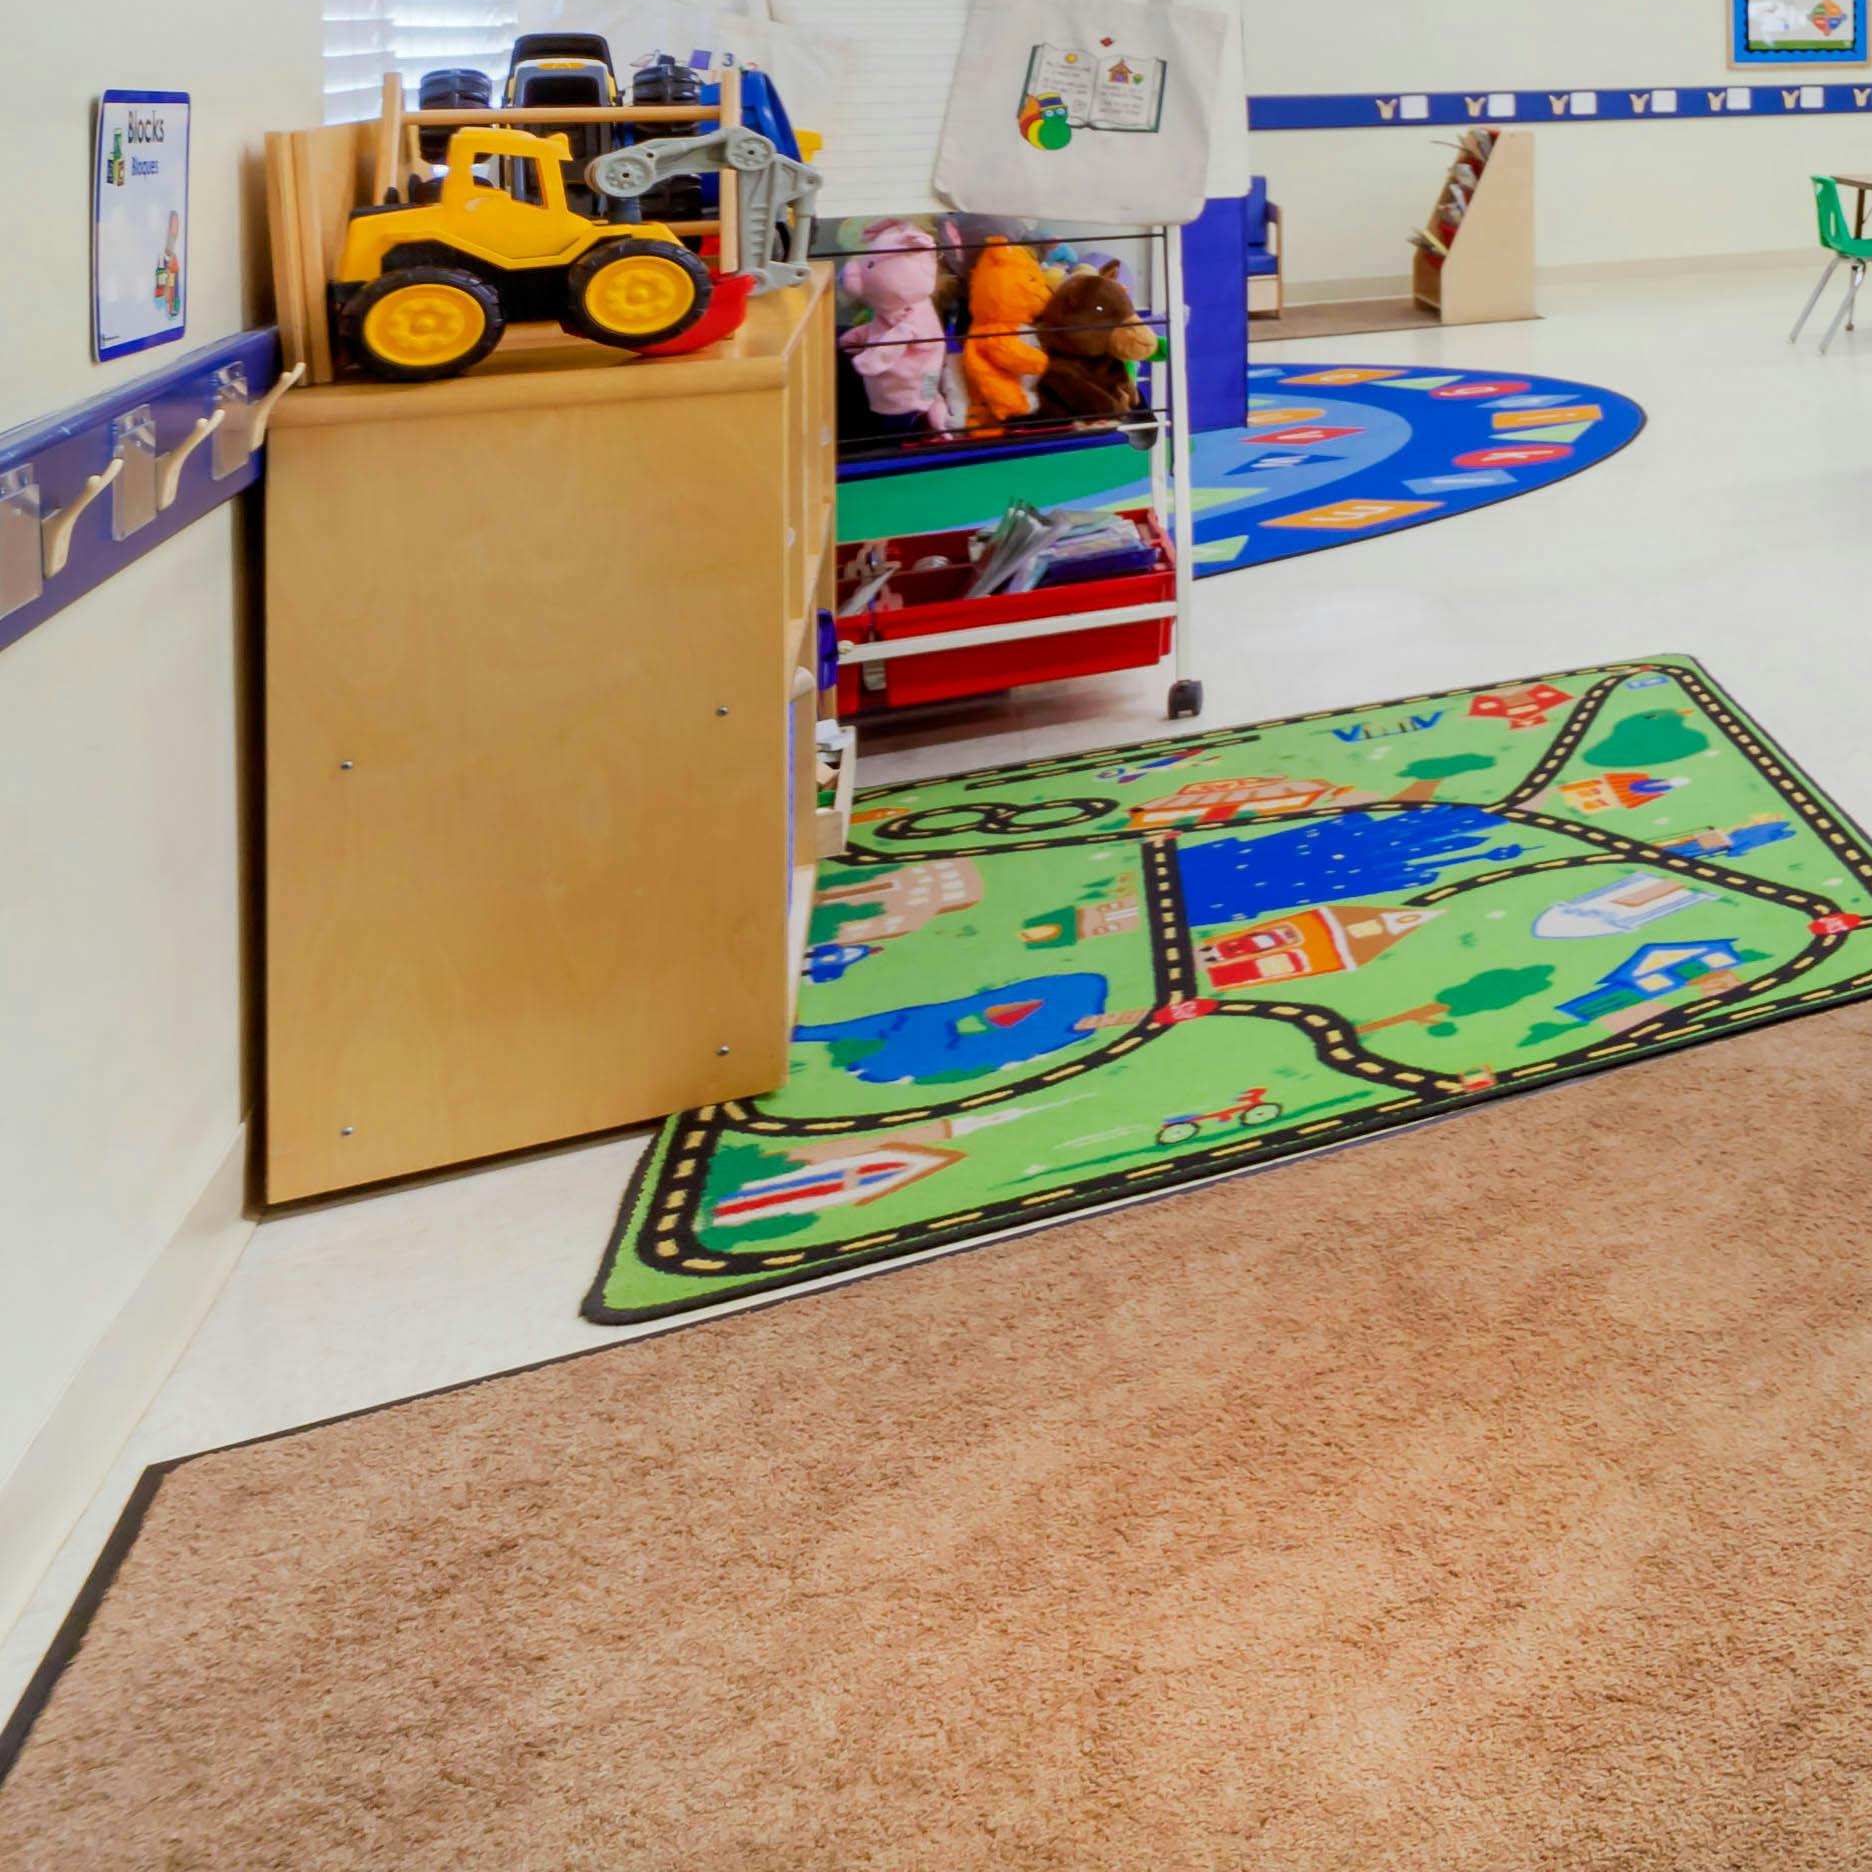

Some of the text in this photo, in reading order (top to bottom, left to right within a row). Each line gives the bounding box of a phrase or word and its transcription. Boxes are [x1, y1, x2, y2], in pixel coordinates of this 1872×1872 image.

[722, 52, 735, 67] 3
[127, 110, 165, 144] Blocks
[131, 156, 159, 179] Bloques
